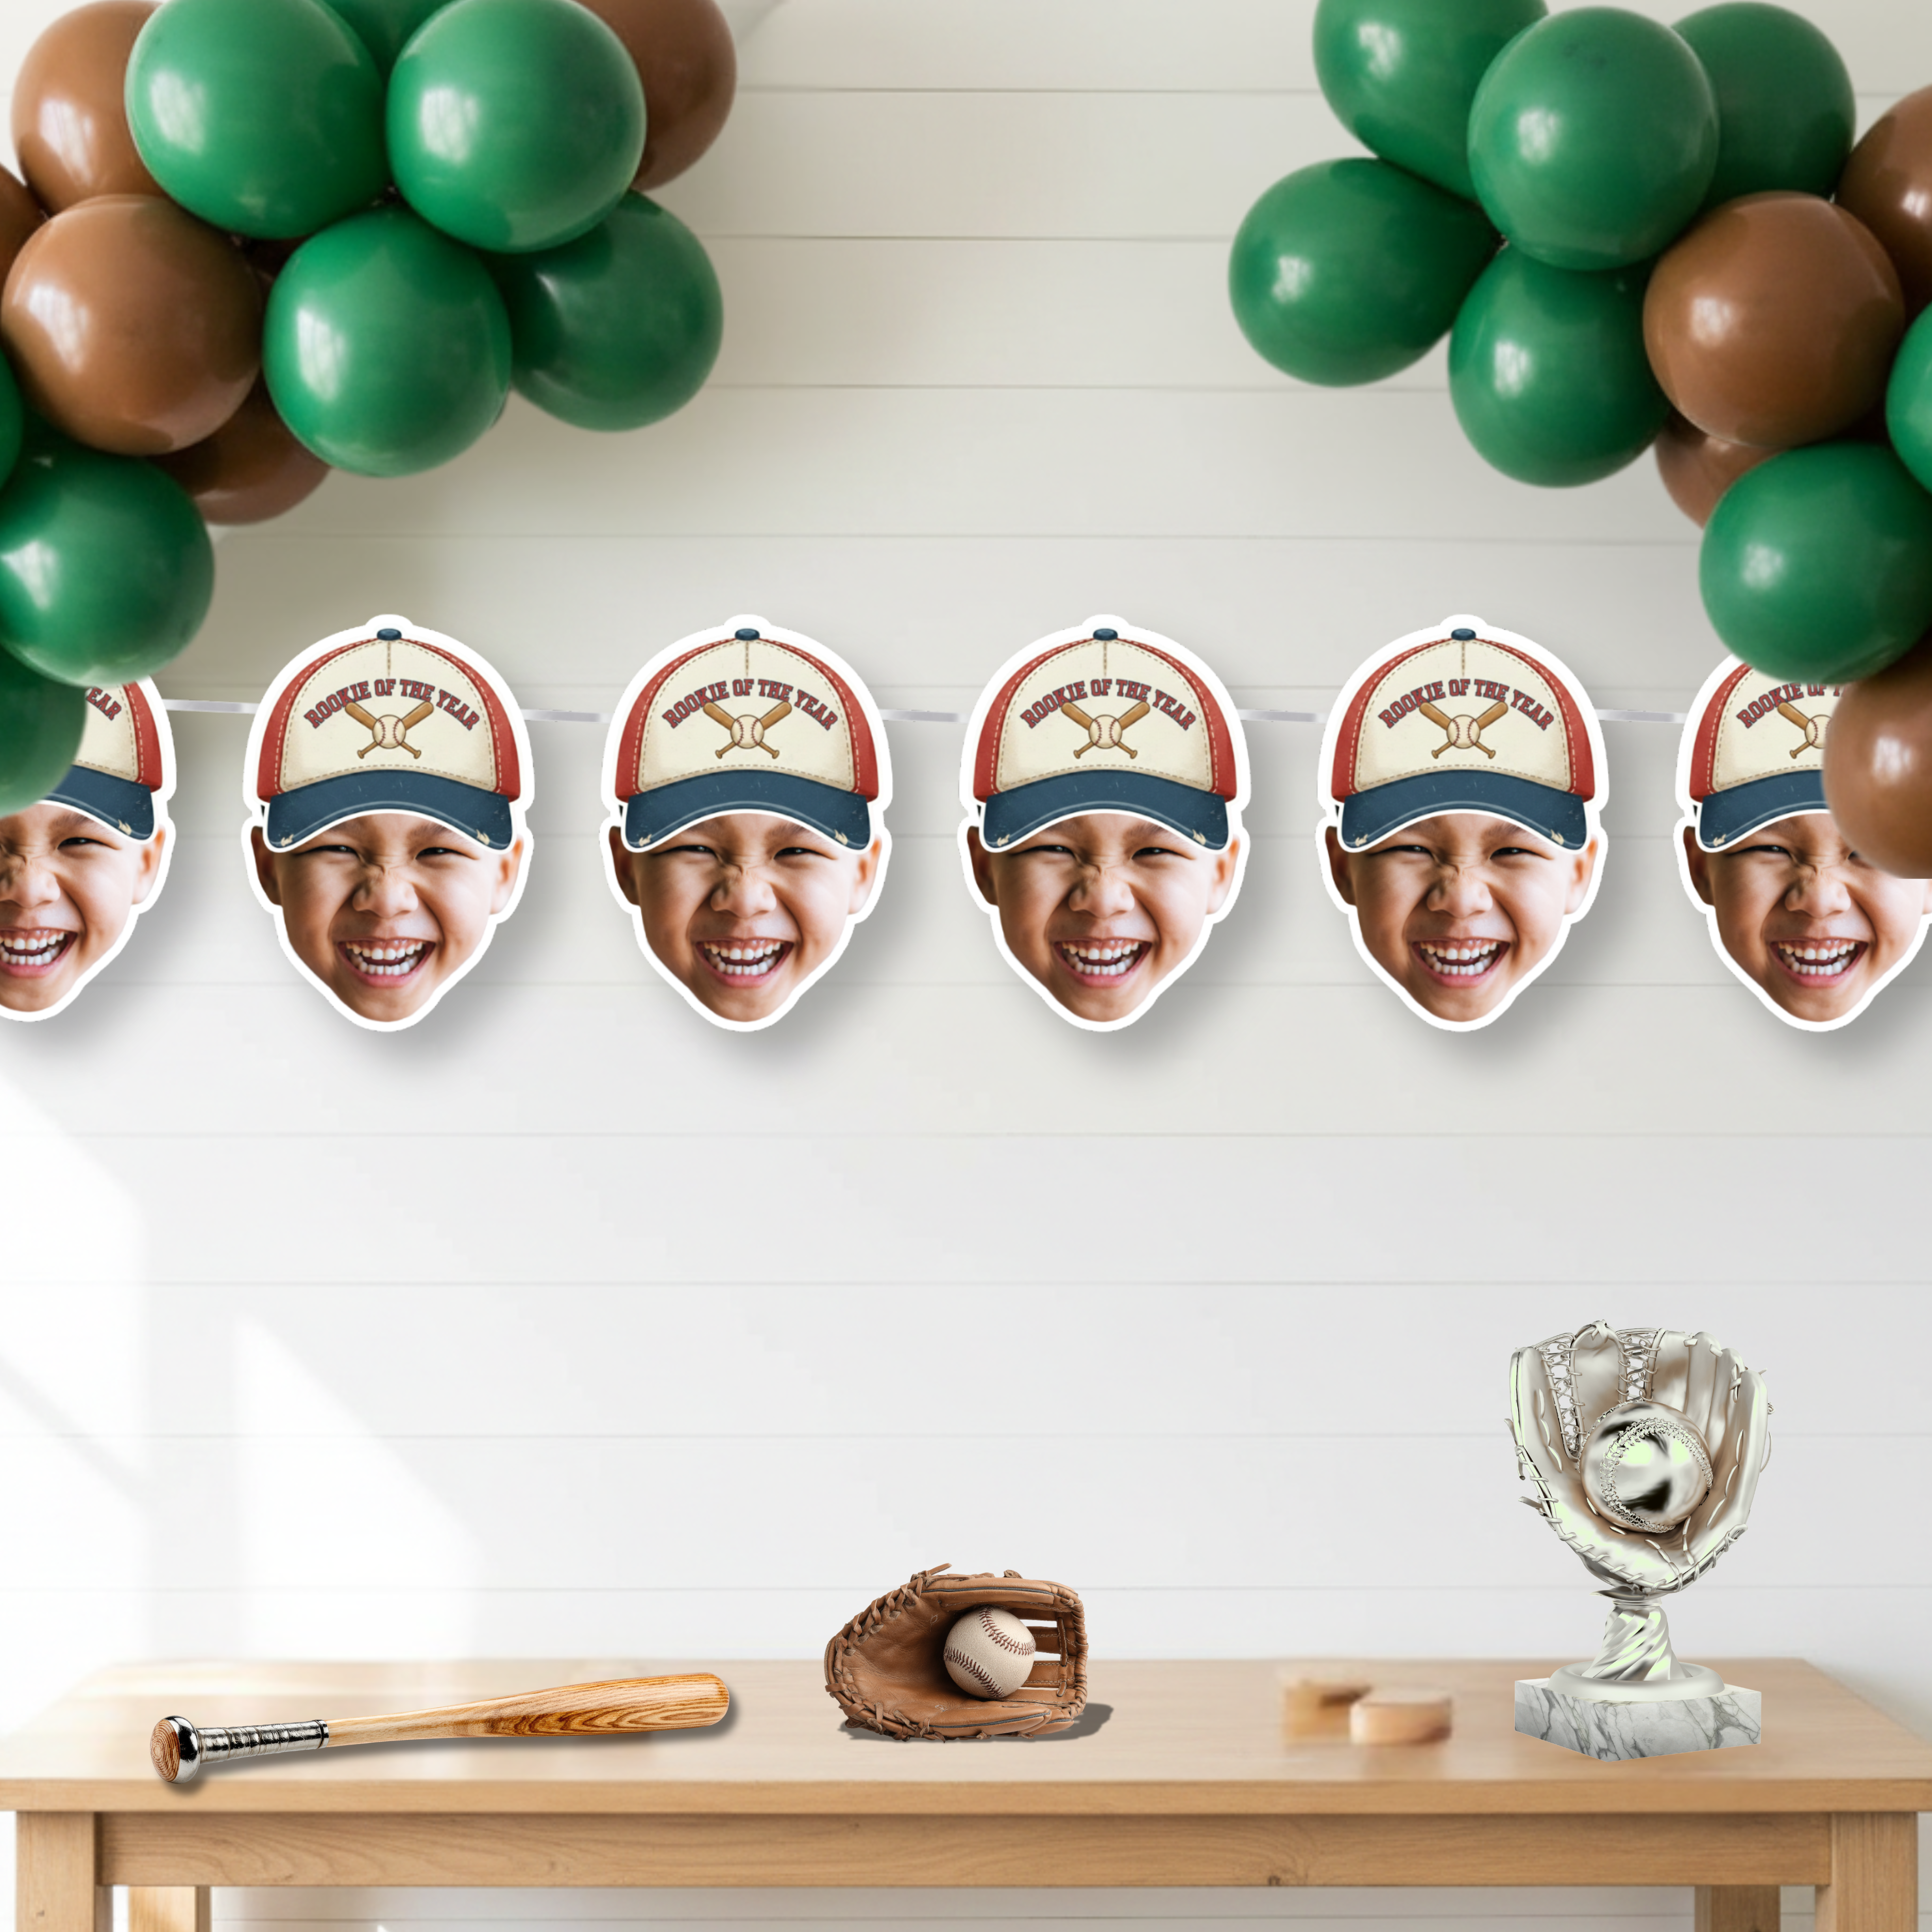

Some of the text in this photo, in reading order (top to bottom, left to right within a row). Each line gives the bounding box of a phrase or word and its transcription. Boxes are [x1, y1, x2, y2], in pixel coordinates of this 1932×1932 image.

[85, 686, 122, 721] EAR
[303, 679, 480, 731] ROOKIE OF THE YEAR
[662, 679, 838, 731] ROOKIE OF THE YEAR
[1020, 679, 1196, 731] ROOKIE OF THE YEAR
[1378, 679, 1554, 731] ROOKIE OF THE YEAR
[1736, 682, 1804, 729] ROOKIE
